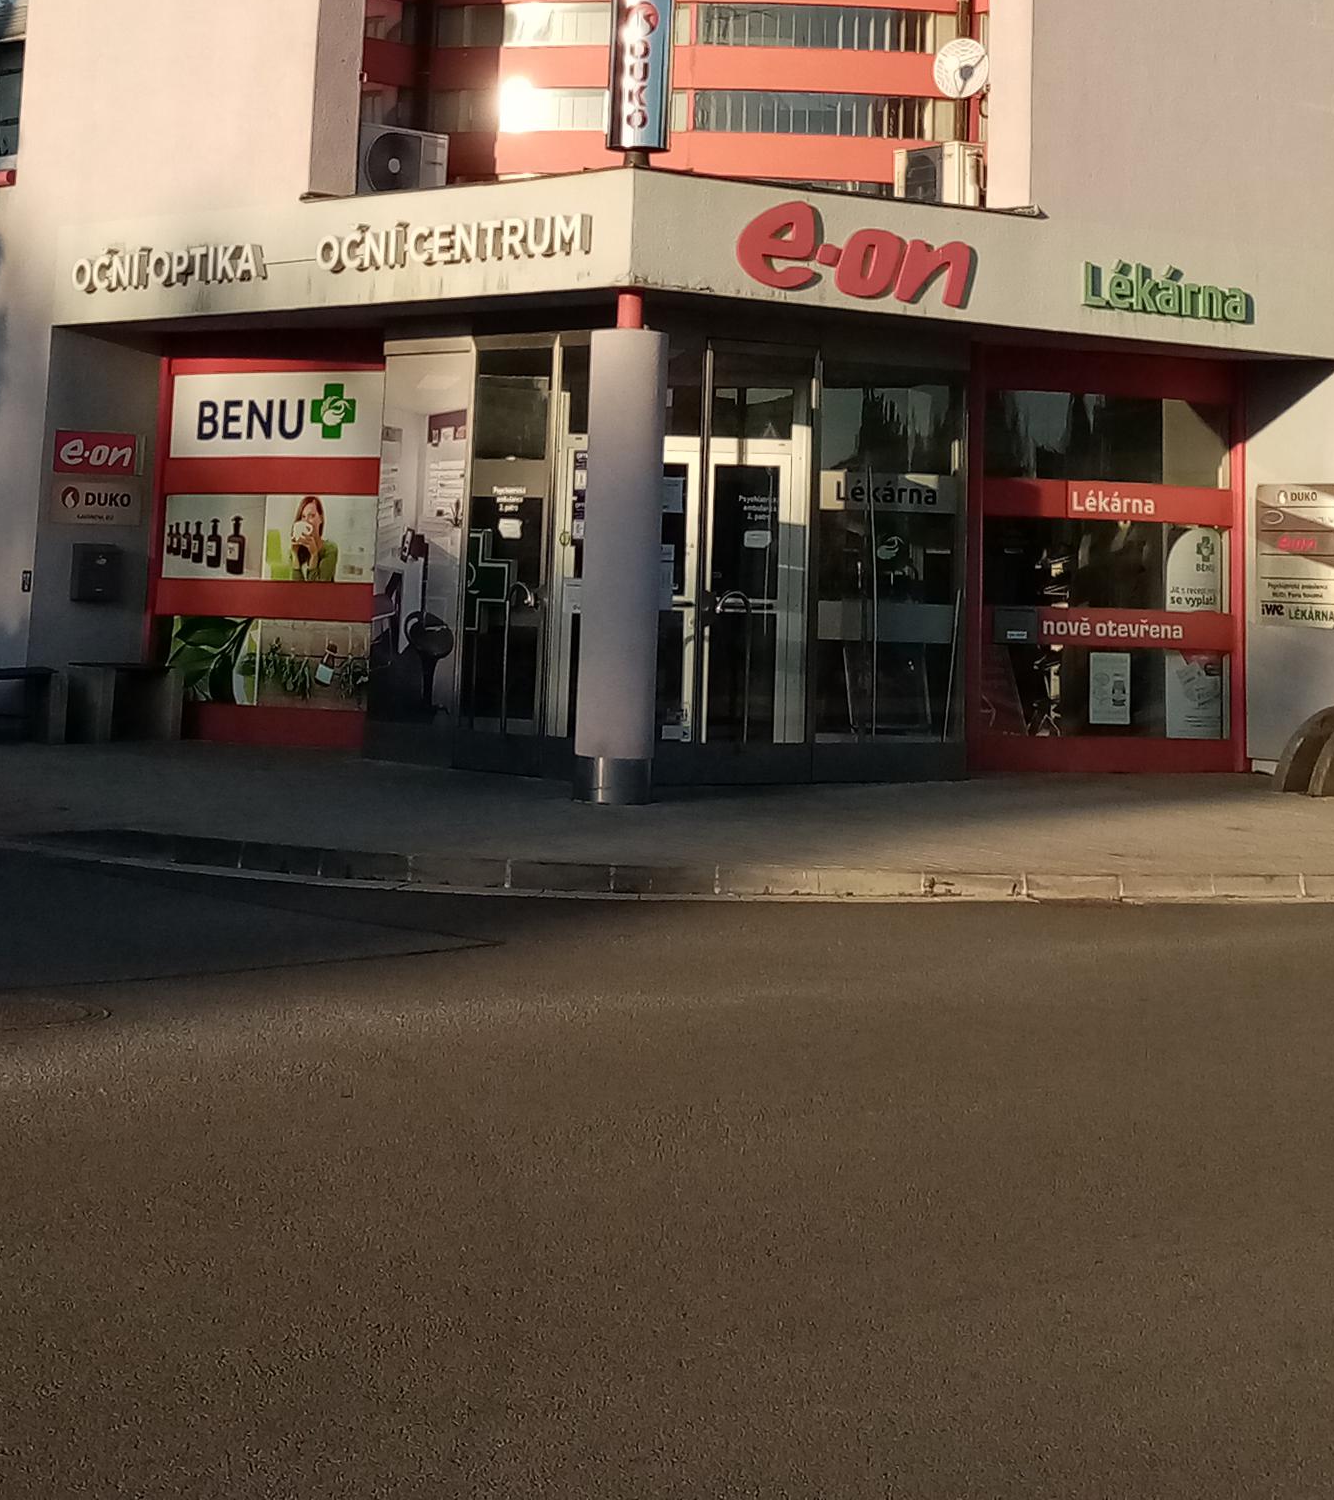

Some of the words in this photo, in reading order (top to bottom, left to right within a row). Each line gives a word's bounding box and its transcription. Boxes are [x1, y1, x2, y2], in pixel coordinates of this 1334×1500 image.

[316, 221, 409, 274] OČNÍ
[409, 214, 593, 267] CENTRUM
[71, 247, 148, 293] OČNÍ
[147, 243, 267, 287] OPTIKA
[1083, 259, 1254, 324] Lékárna
[197, 399, 305, 440] BENU
[85, 492, 131, 507] DUKO
[836, 480, 937, 505] Lékárna
[1072, 490, 1155, 514] Lékárna
[1290, 492, 1318, 501] DUKO
[1170, 596, 1183, 604] se
[1043, 617, 1091, 636] nově
[1095, 619, 1184, 639] otevřena
